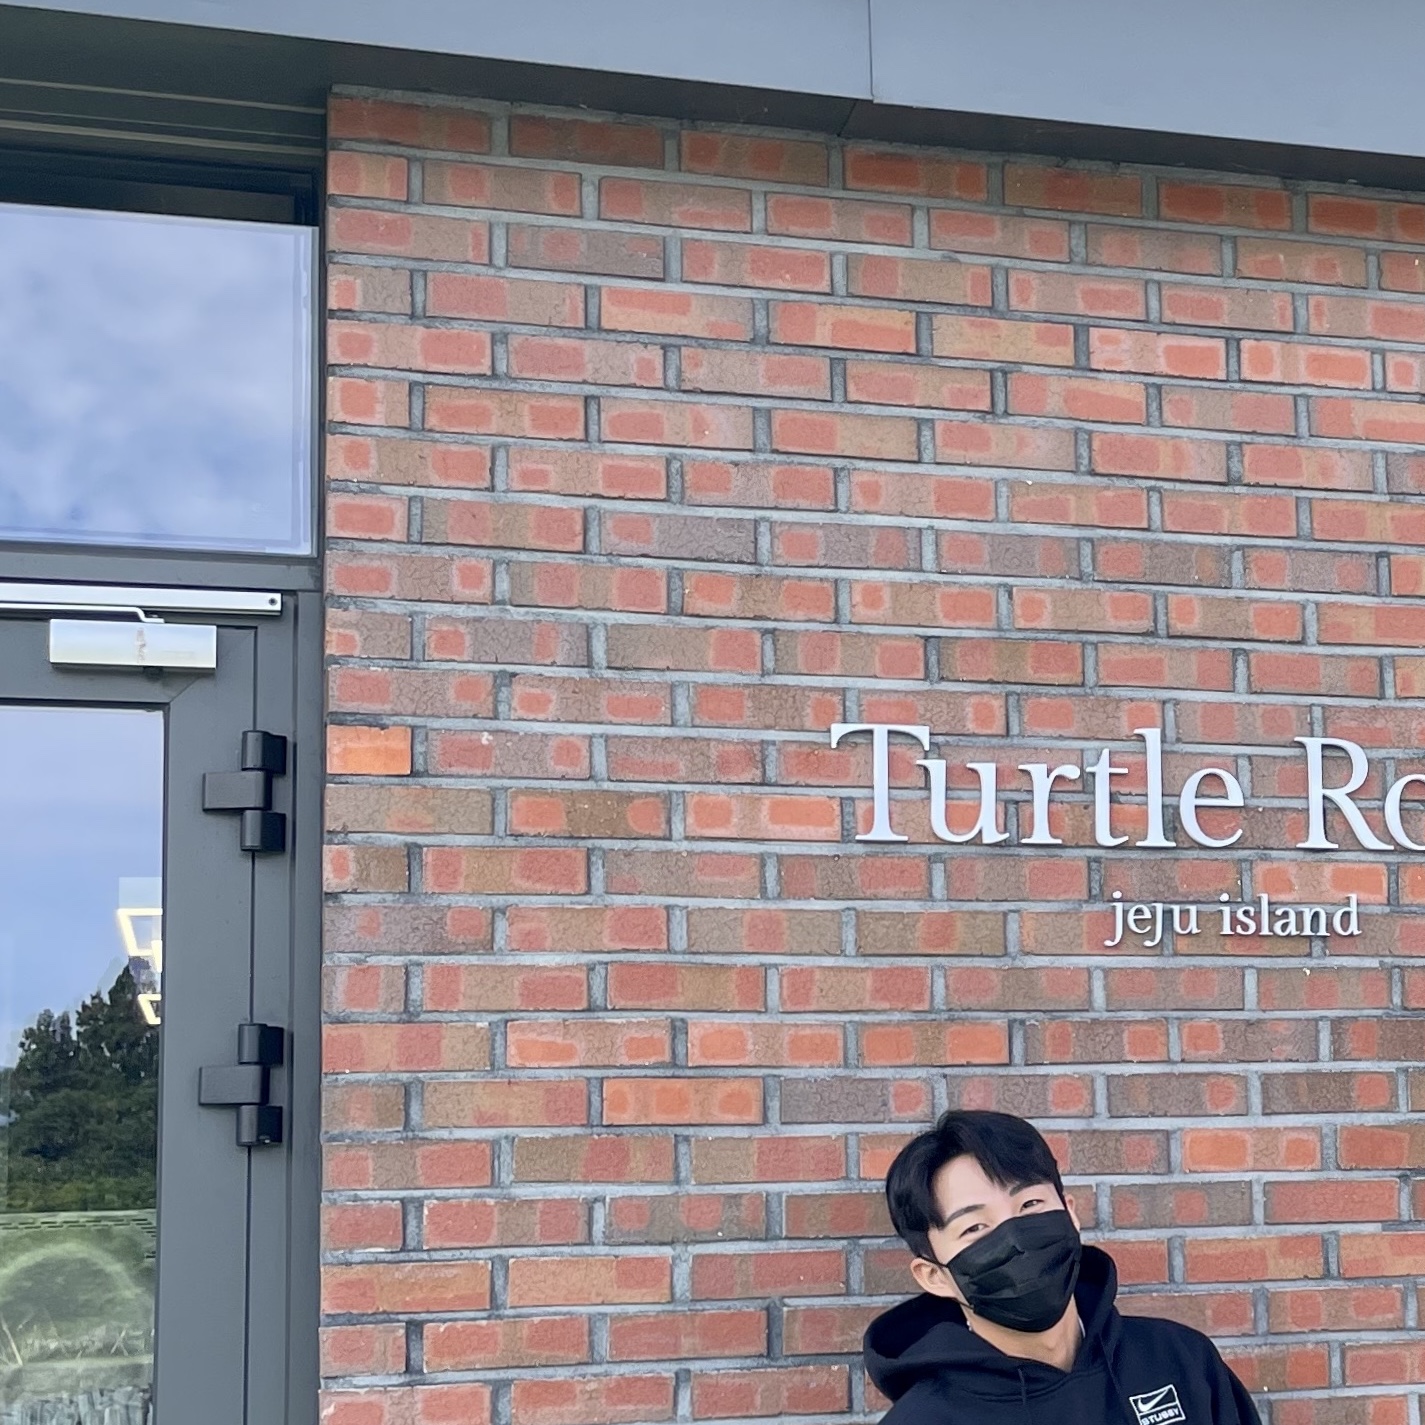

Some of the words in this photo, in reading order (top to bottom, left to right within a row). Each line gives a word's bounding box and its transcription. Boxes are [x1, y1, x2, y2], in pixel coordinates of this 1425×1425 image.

[830, 722, 1247, 849] Turtle
[1104, 890, 1202, 947] jeju
[1218, 892, 1362, 937] island
